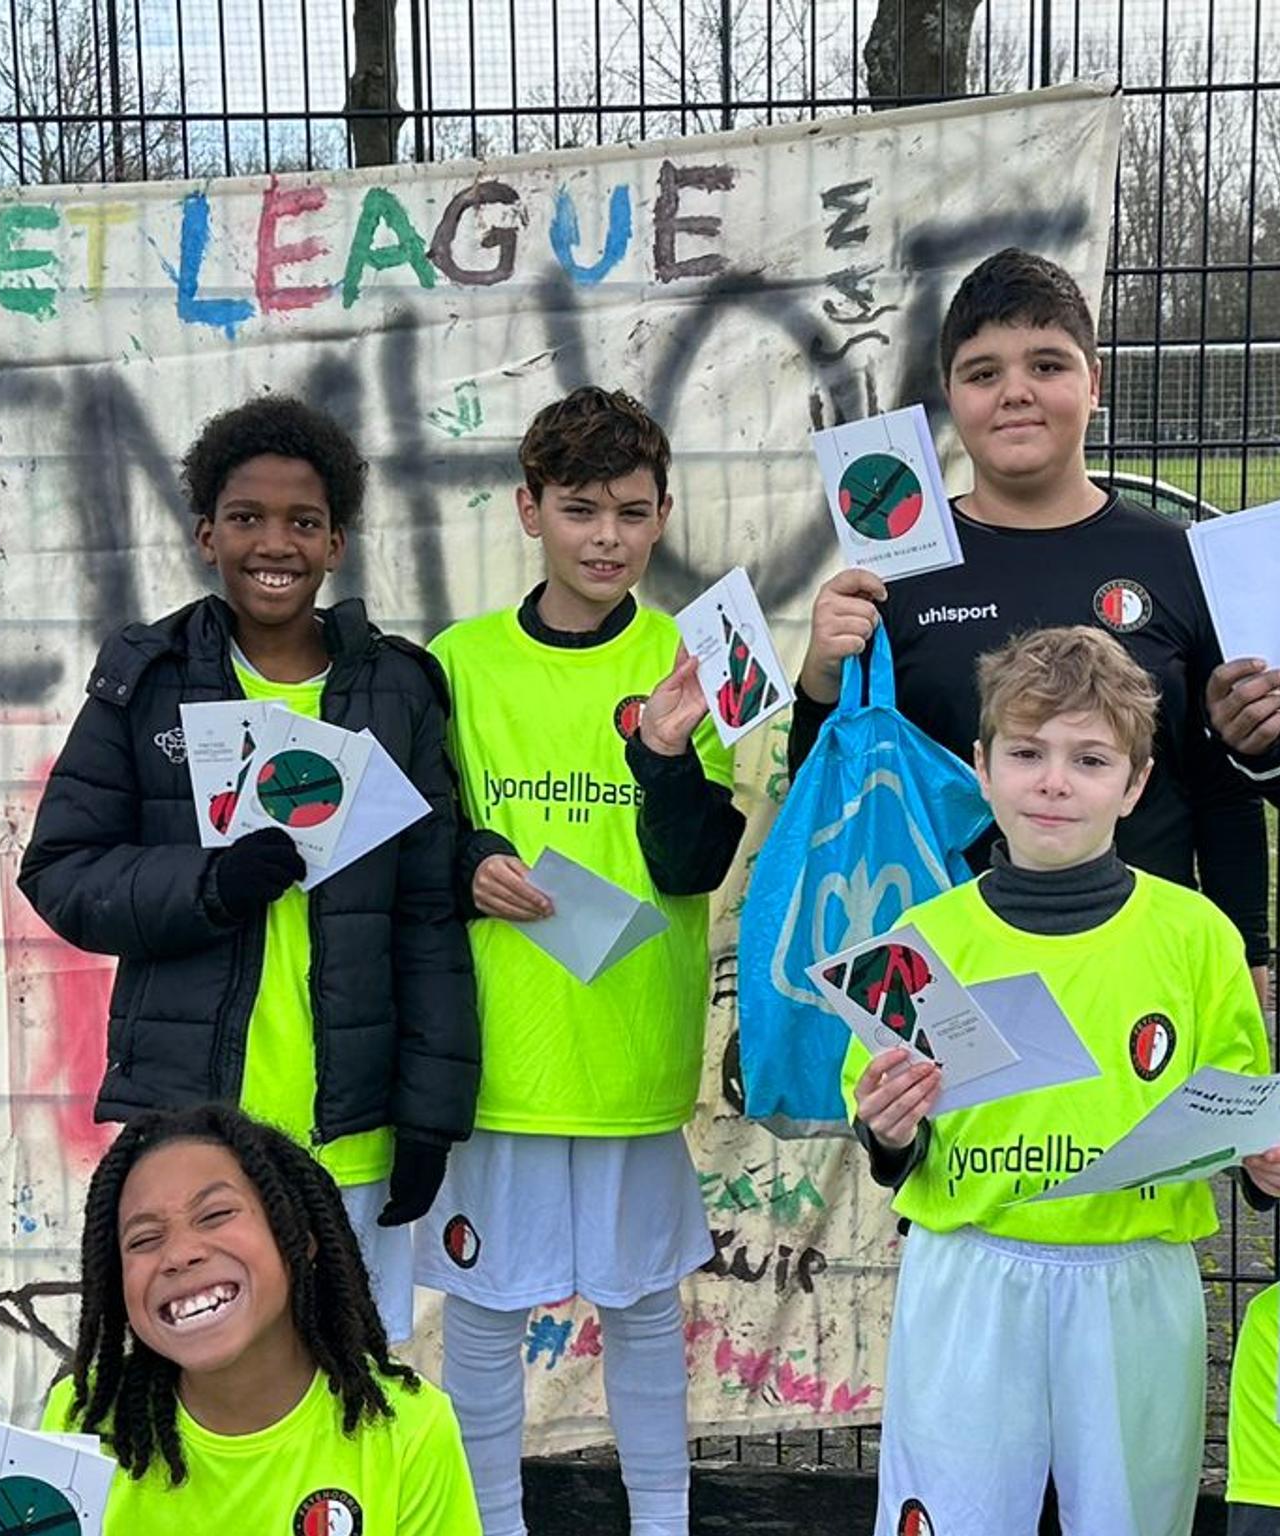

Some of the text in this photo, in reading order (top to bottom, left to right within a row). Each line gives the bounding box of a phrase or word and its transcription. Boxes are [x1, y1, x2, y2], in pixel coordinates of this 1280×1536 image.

[160, 157, 736, 338] LEAGUE
[918, 603, 998, 625] uhlsport
[483, 768, 644, 807] lyondellbase
